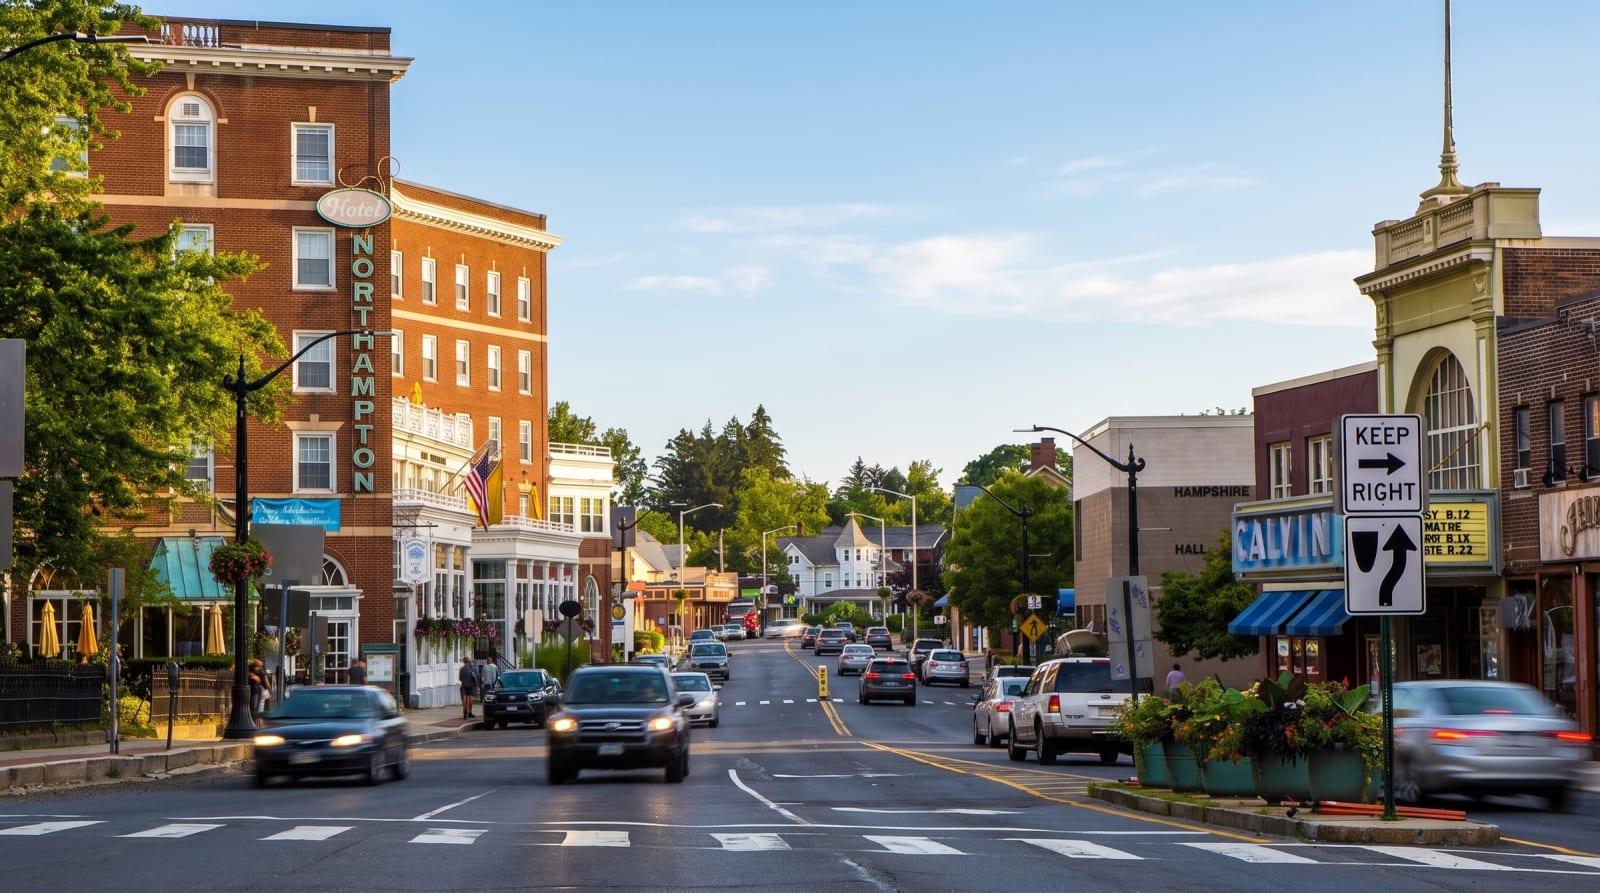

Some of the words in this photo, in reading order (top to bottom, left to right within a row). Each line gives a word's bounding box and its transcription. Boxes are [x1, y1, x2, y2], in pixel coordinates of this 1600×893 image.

[326, 197, 382, 217] Hotel
[352, 234, 375, 492] NORTHAMPTON
[1355, 426, 1410, 446] KEEP
[1173, 485, 1250, 498] HAMPSHIRE
[1352, 482, 1416, 502] RIGHT
[1423, 510, 1438, 519] SY
[1424, 522, 1461, 531] MATRE
[1236, 512, 1331, 562] CALVIN
[1174, 543, 1207, 555] HALL
